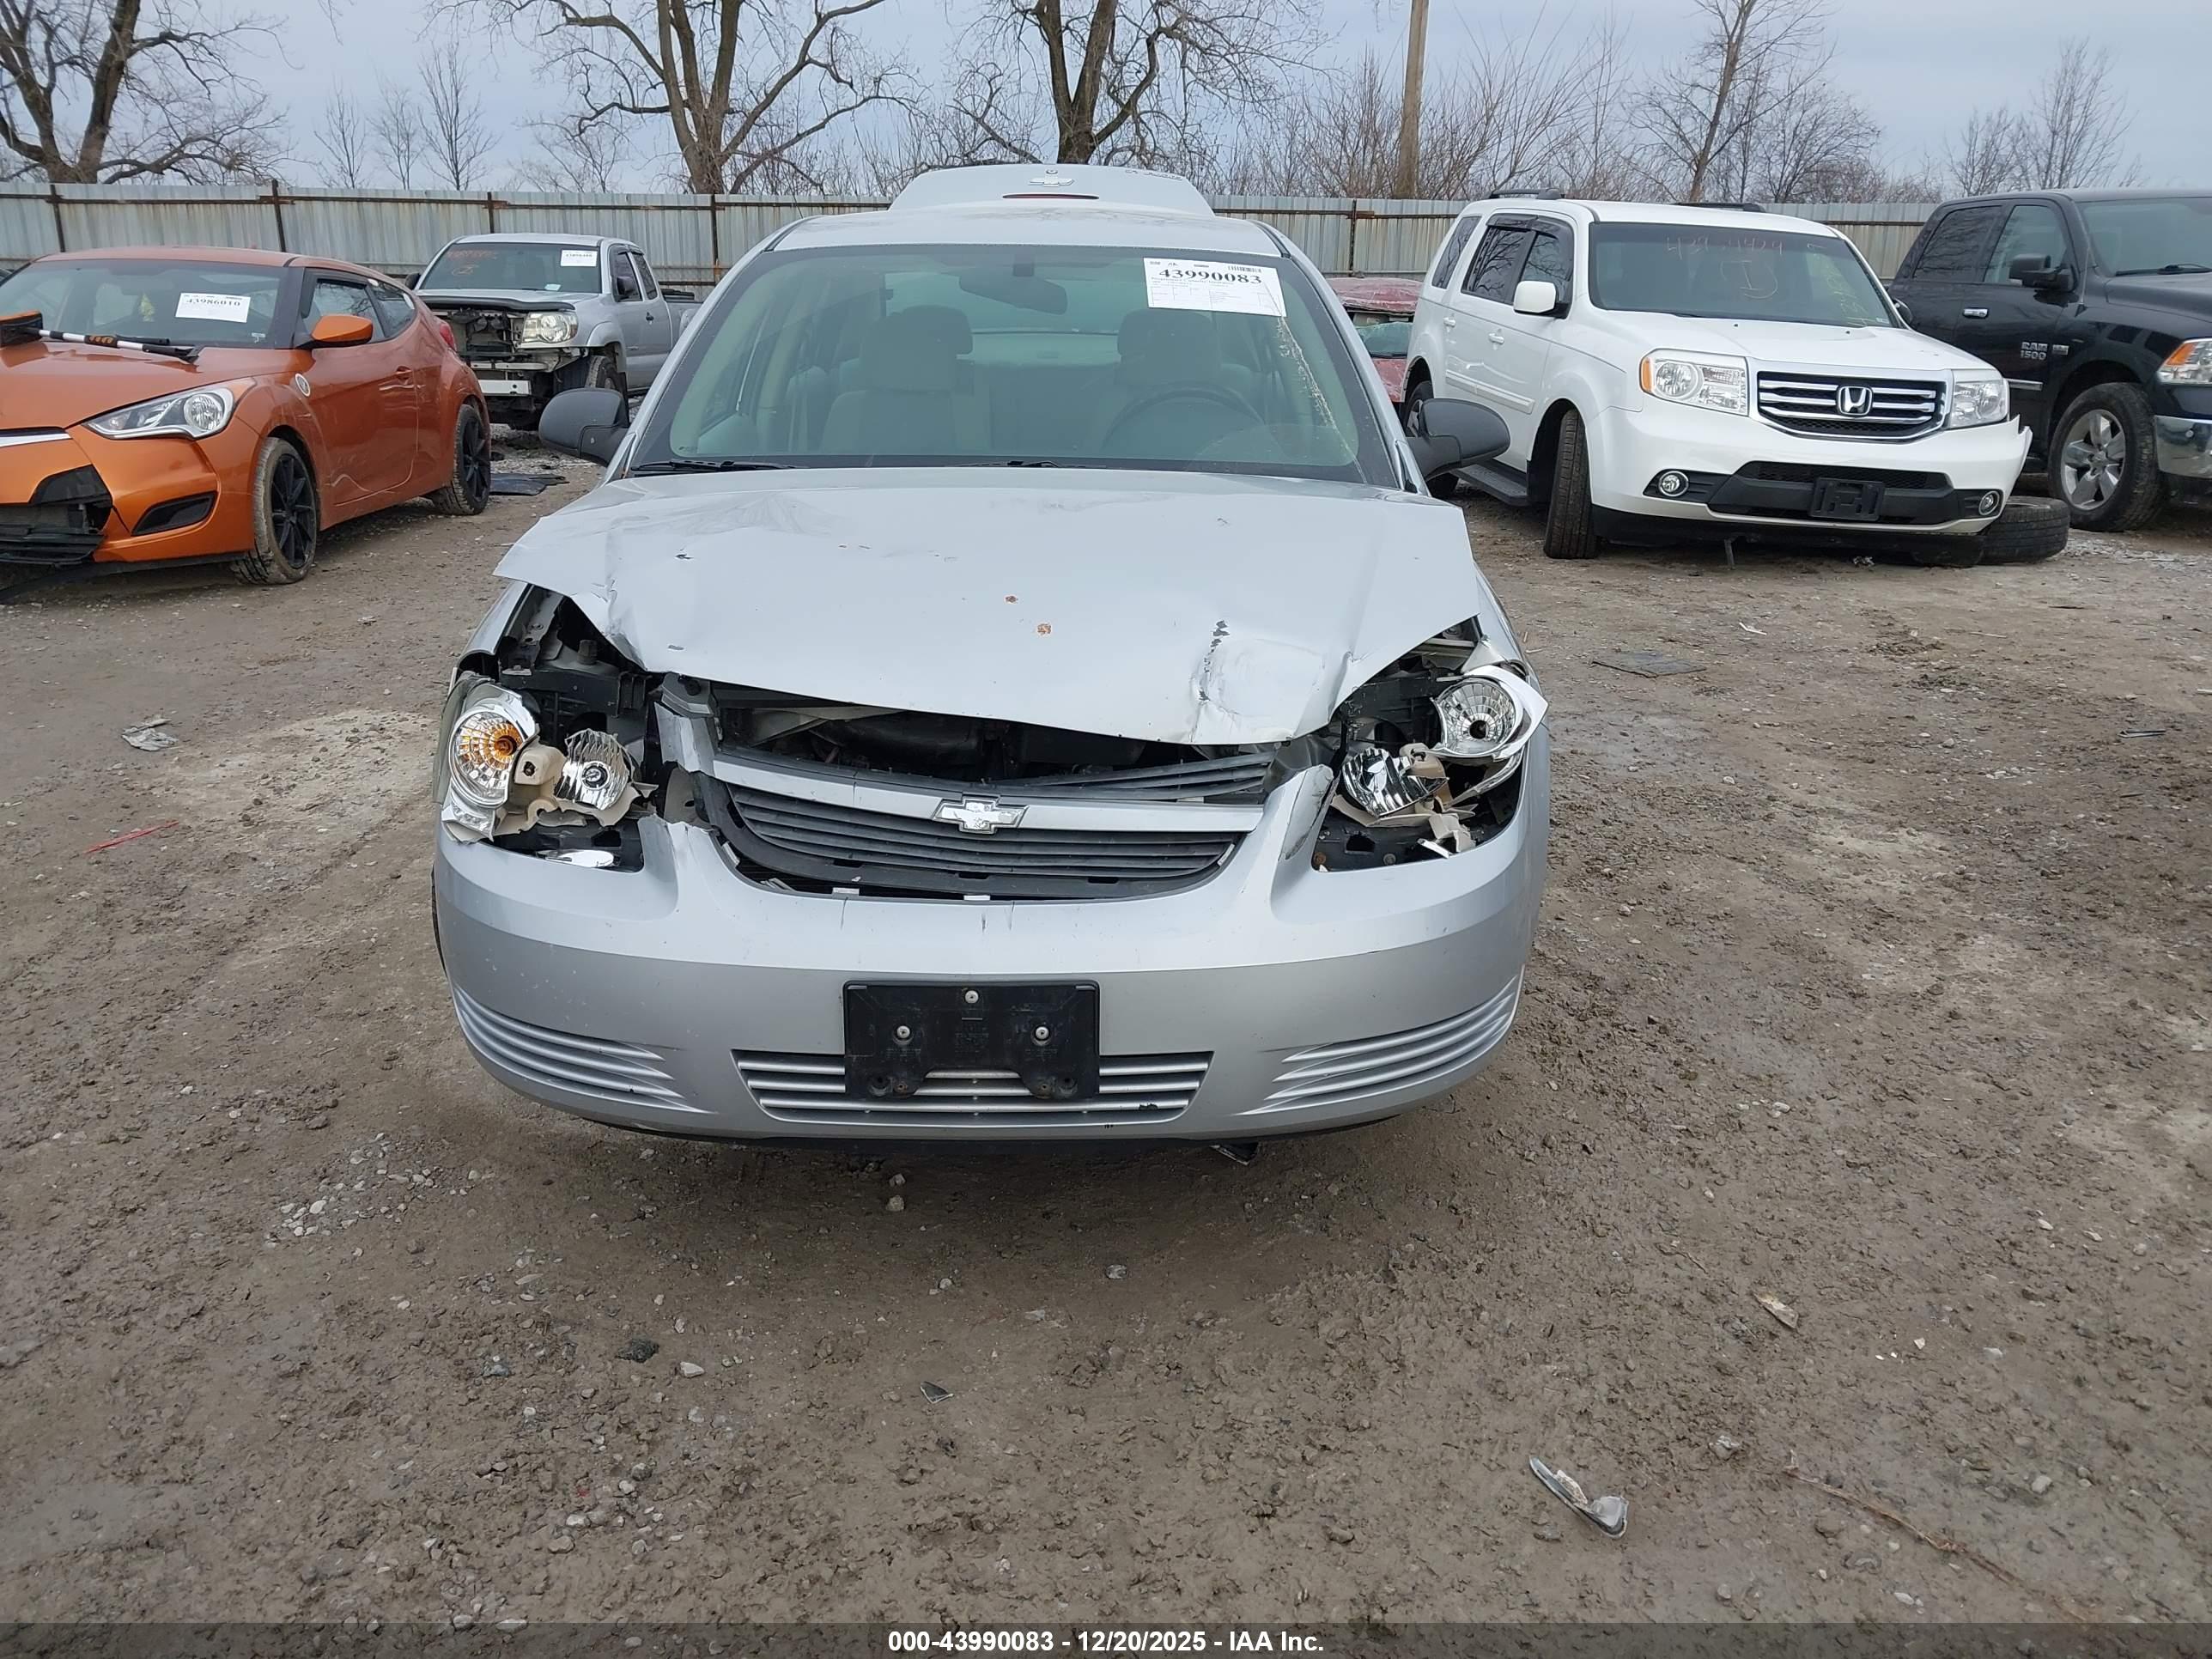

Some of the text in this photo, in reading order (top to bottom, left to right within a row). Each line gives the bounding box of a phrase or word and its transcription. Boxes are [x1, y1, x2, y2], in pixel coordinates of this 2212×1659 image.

[1159, 268, 1262, 284] 43990083
[2021, 342, 2048, 351] RAM
[2021, 350, 2047, 361] 1500
